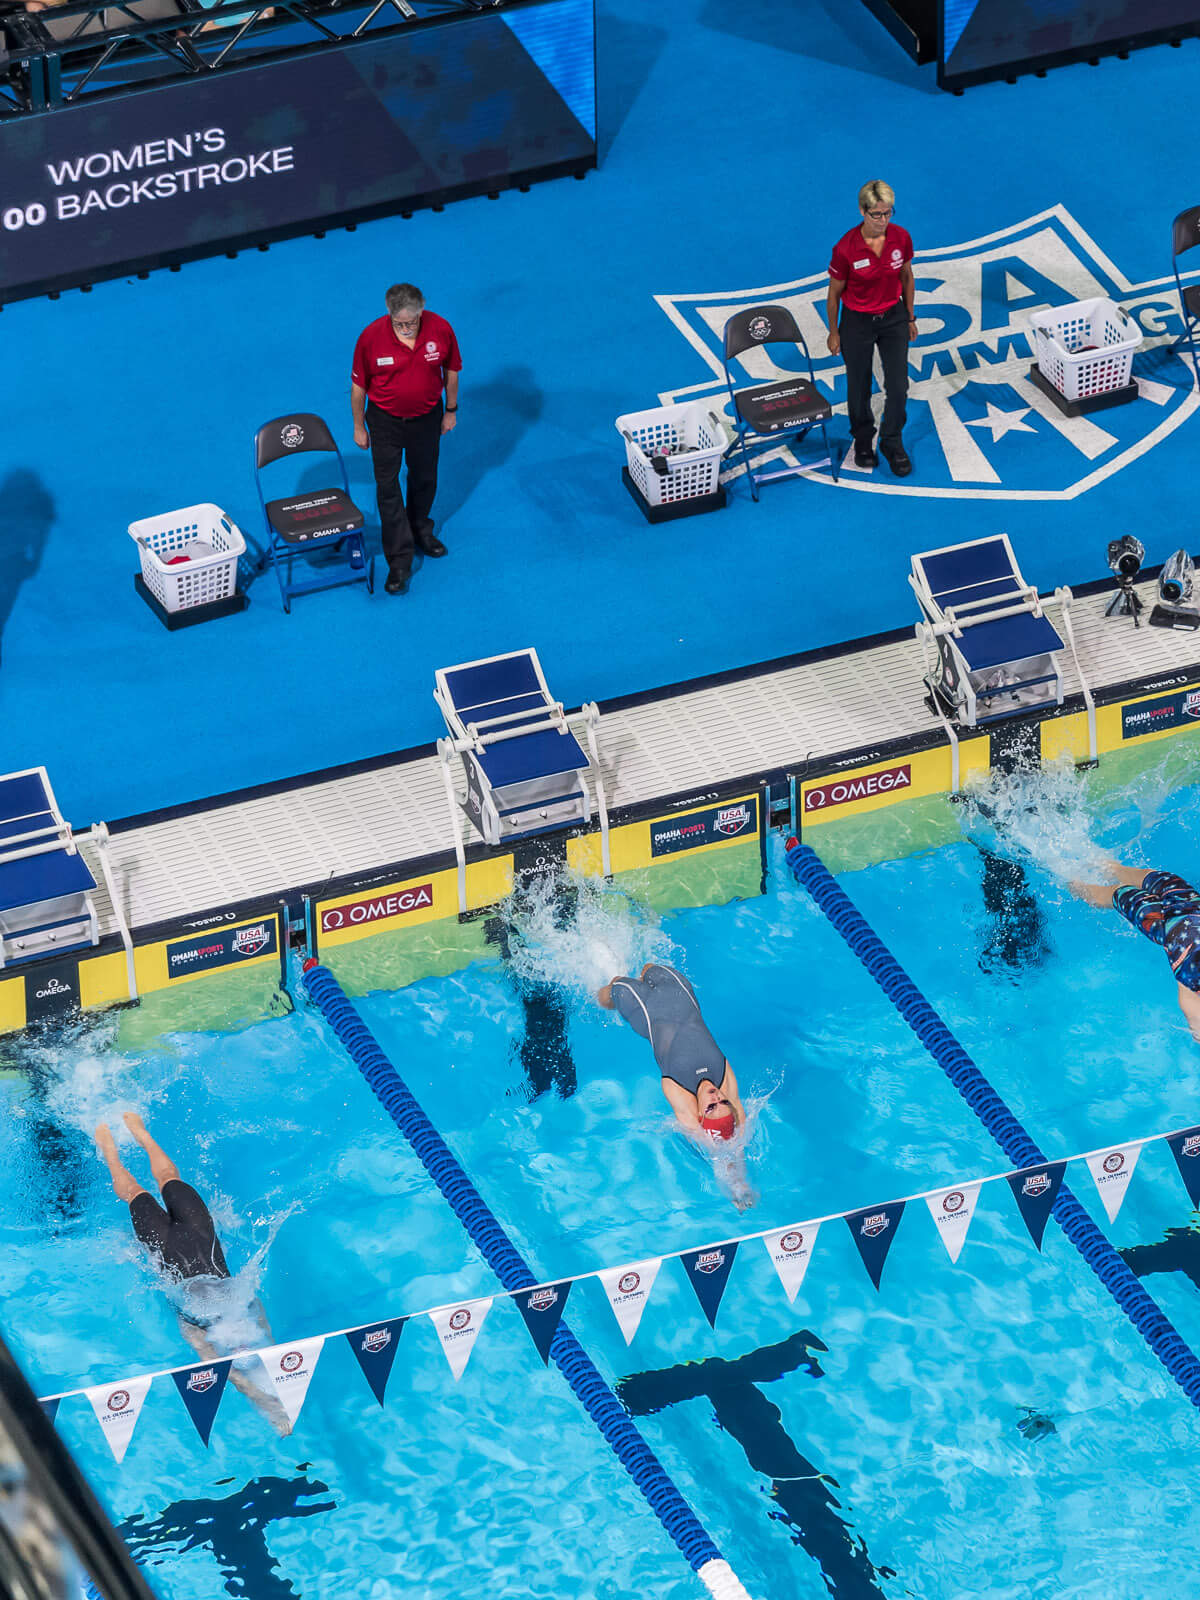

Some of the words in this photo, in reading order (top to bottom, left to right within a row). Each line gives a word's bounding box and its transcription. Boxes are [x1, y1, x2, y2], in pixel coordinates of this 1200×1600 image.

[56, 146, 294, 220] BACKSTROKE
[831, 770, 910, 801] OMEGA
[721, 809, 742, 820] USA
[523, 862, 557, 875] OMEGA
[350, 890, 431, 922] OMEGA
[240, 928, 261, 940] USA
[35, 982, 72, 999] OMEGA
[1028, 1176, 1044, 1184] USA
[866, 1216, 882, 1226] USA
[701, 1253, 718, 1262] USA
[534, 1290, 551, 1300] USA
[368, 1332, 384, 1342] USA
[193, 1372, 211, 1381] USA
